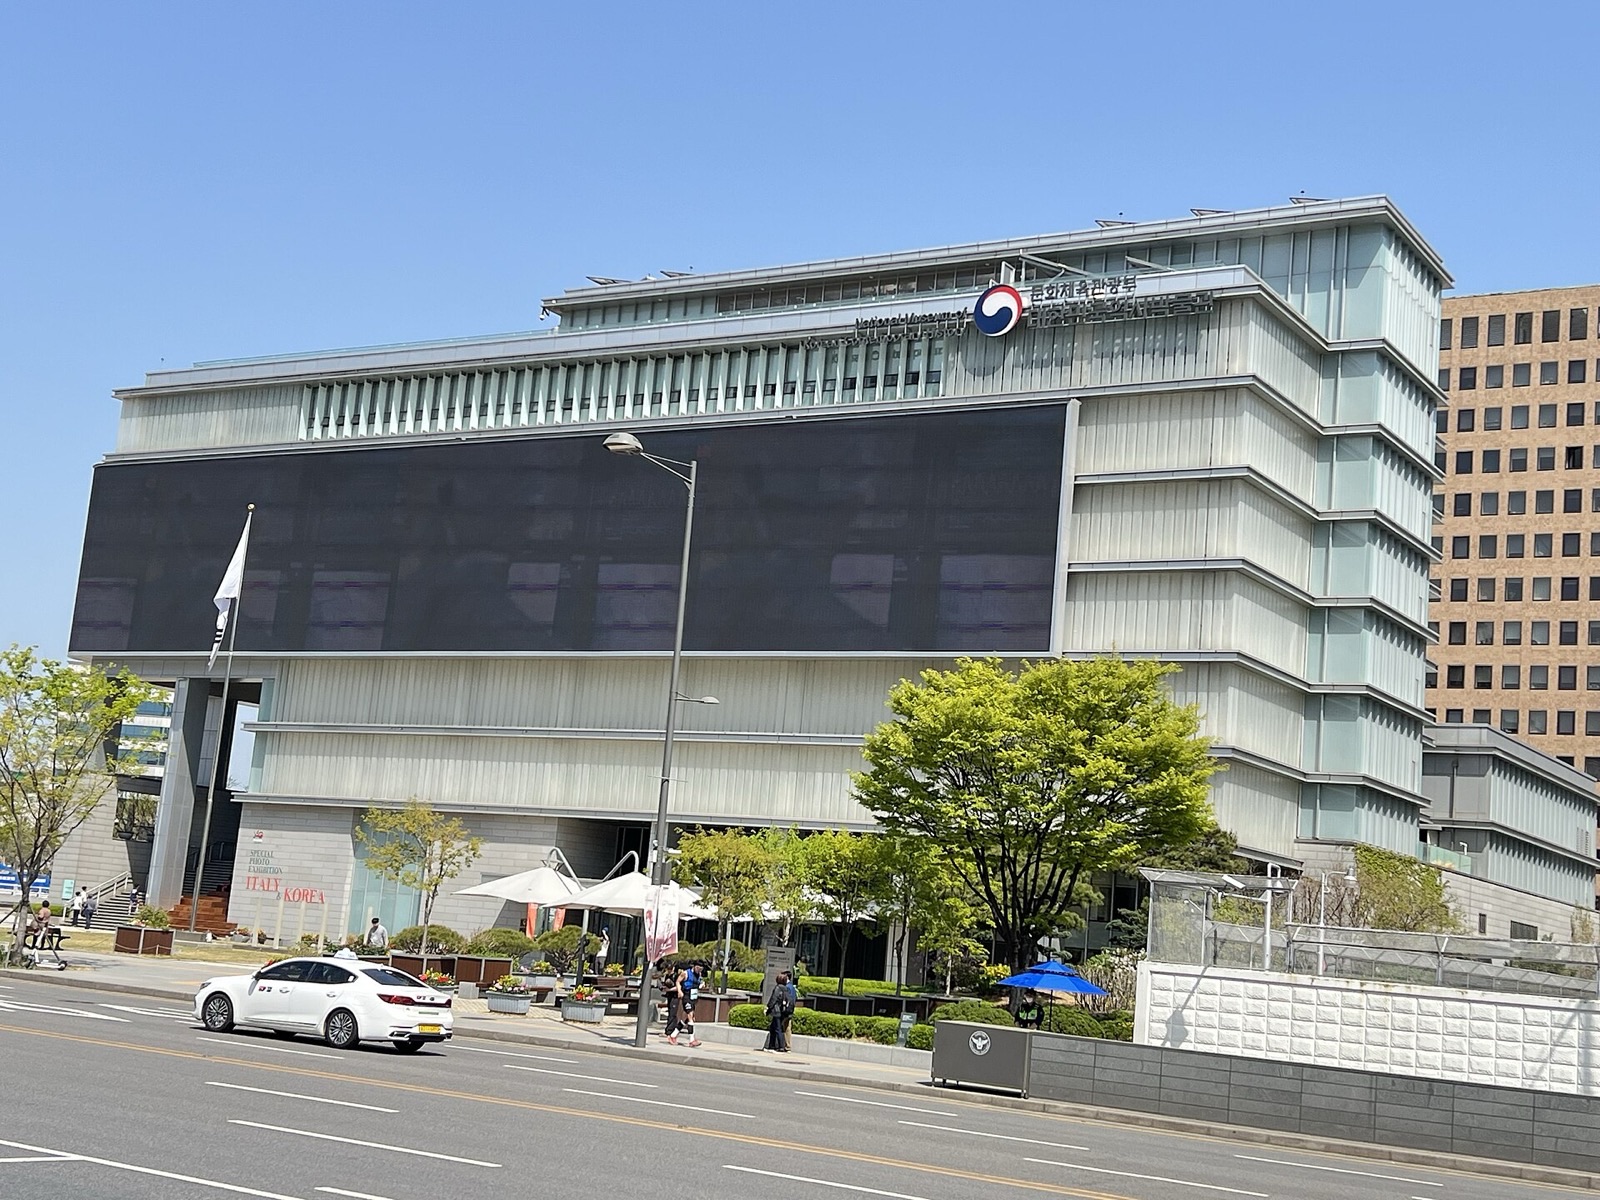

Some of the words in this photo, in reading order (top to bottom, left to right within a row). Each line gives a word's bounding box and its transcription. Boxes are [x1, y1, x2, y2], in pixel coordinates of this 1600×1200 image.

[855, 313, 902, 329] National
[904, 311, 952, 324] Museum
[954, 306, 968, 320] of
[249, 857, 270, 865] PHOTO
[248, 866, 283, 874] EXHIBITION
[246, 876, 283, 892] ITALY
[284, 888, 325, 904] KOREA
